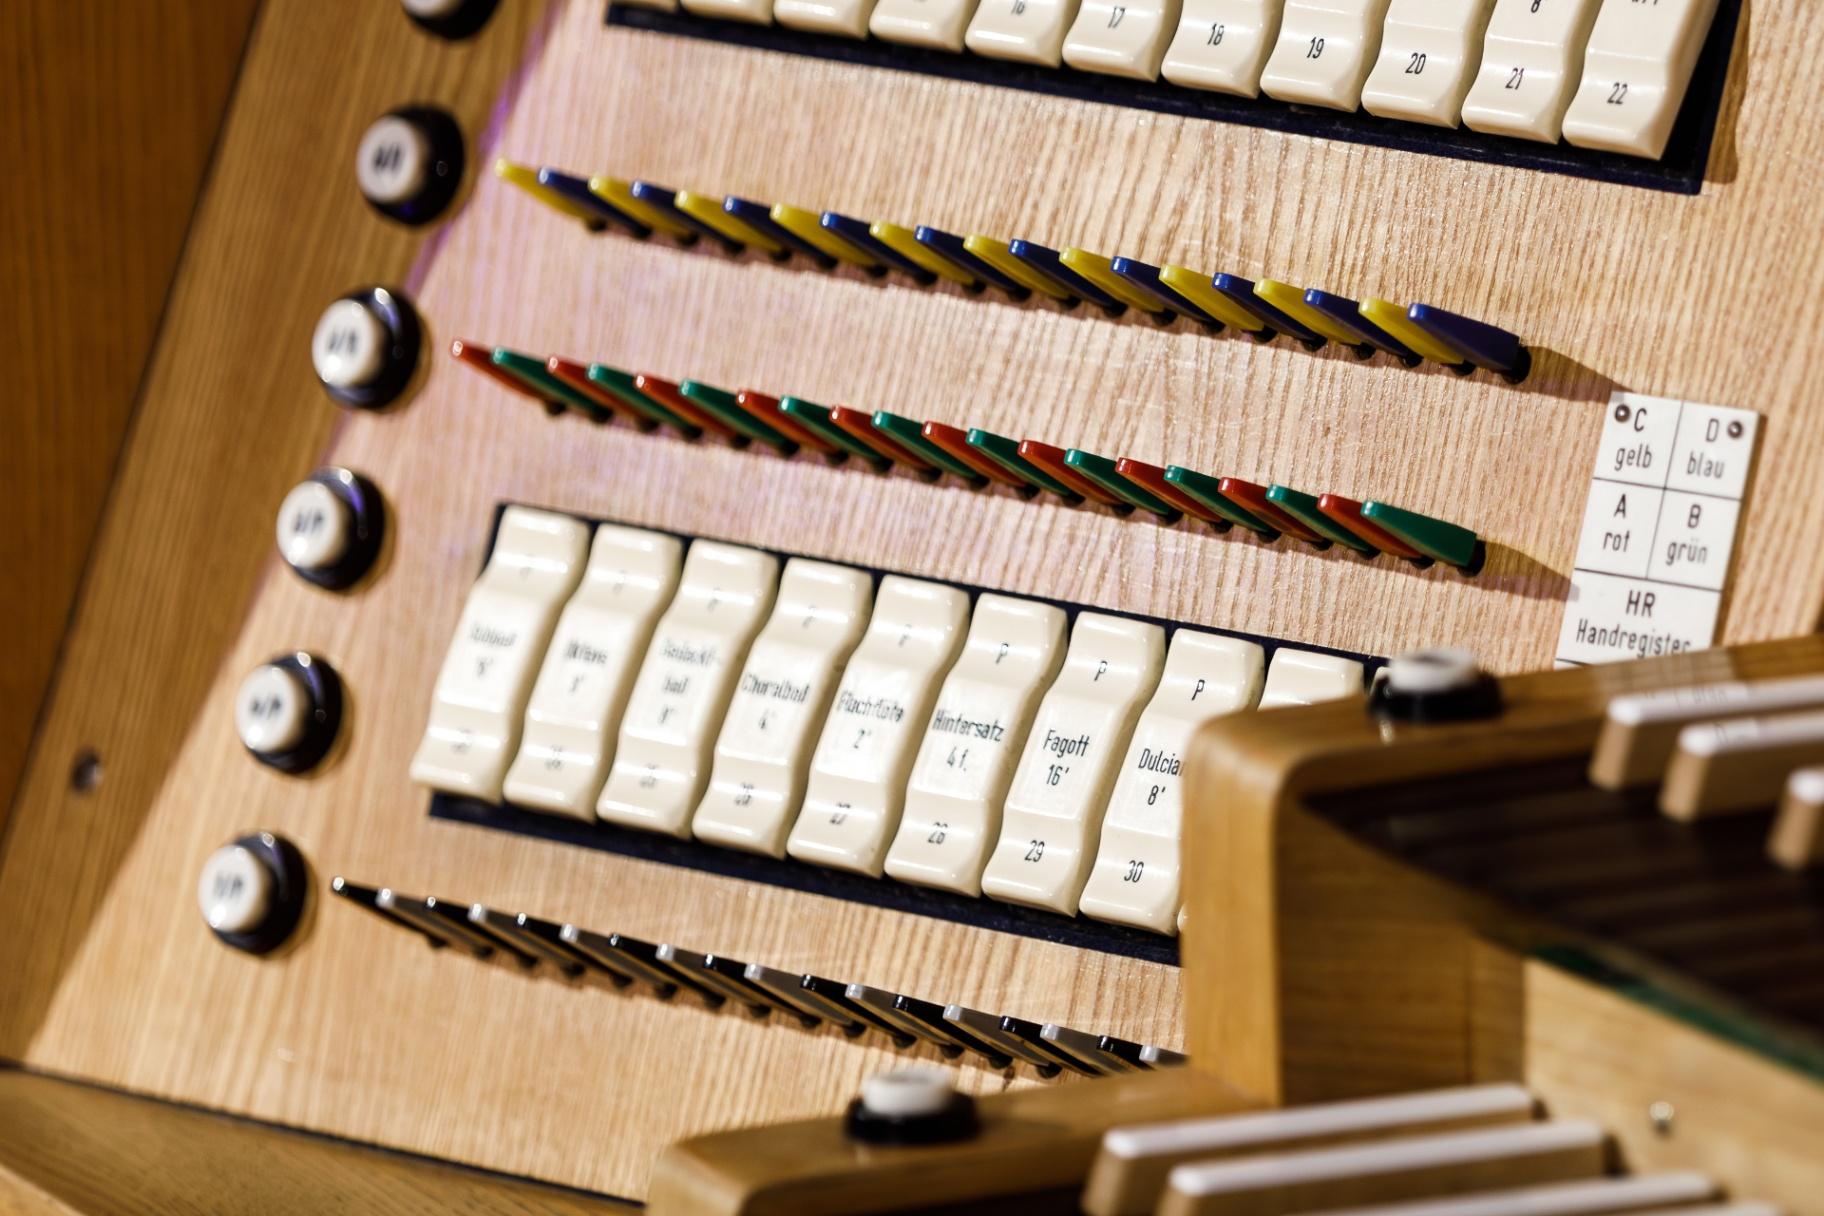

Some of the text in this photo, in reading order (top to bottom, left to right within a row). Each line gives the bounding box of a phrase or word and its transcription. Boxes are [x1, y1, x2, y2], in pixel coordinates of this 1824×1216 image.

[1107, 5, 1126, 29] 17
[1207, 23, 1225, 46] 18
[1306, 36, 1326, 59] 19
[1404, 52, 1427, 75] 20
[1505, 67, 1525, 90] 21
[1606, 82, 1629, 105] 22
[1633, 407, 1648, 433] C
[1705, 418, 1720, 443] D
[1614, 443, 1653, 471] gelb
[1686, 451, 1725, 479] blau
[1613, 493, 1628, 518] A
[1687, 504, 1702, 529] B
[1602, 530, 1630, 553] rot
[1665, 536, 1708, 566] grün
[1625, 589, 1656, 617] HR
[1576, 618, 1692, 659] Handregister
[1094, 660, 1108, 682] P
[1191, 678, 1206, 701] P
[932, 708, 1005, 743] Hintersatz
[1042, 729, 1090, 759] Fagott
[946, 745, 958, 768] 4
[1046, 764, 1070, 786] 16'
[1147, 785, 1166, 806] 8'
[1024, 839, 1046, 863] 29
[1123, 859, 1145, 884] 30
